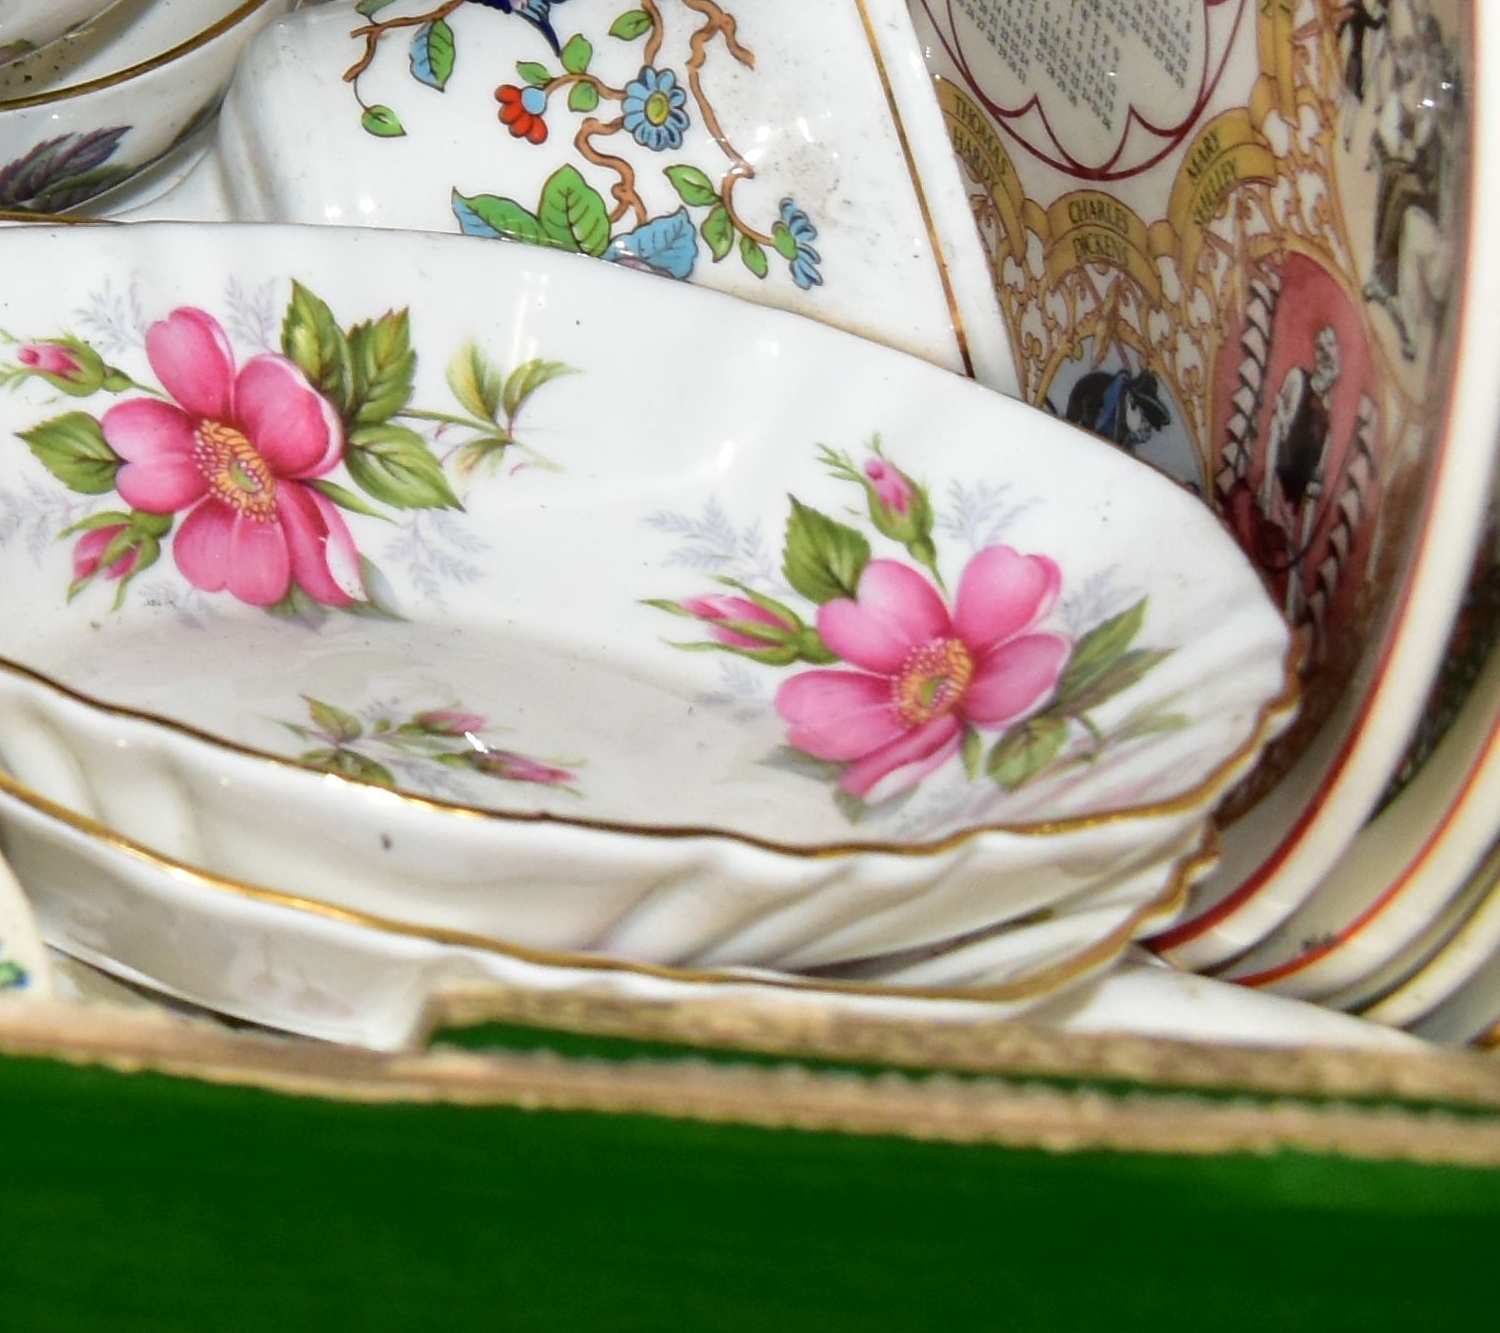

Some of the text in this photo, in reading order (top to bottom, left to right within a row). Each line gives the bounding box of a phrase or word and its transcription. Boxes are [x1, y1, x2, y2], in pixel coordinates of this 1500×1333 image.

[953, 95, 1009, 177] THOMAS
[953, 126, 997, 184] HARDY
[1187, 131, 1221, 181] MARY
[1068, 199, 1130, 230] CHARLES
[1072, 234, 1130, 266] DICKENS
